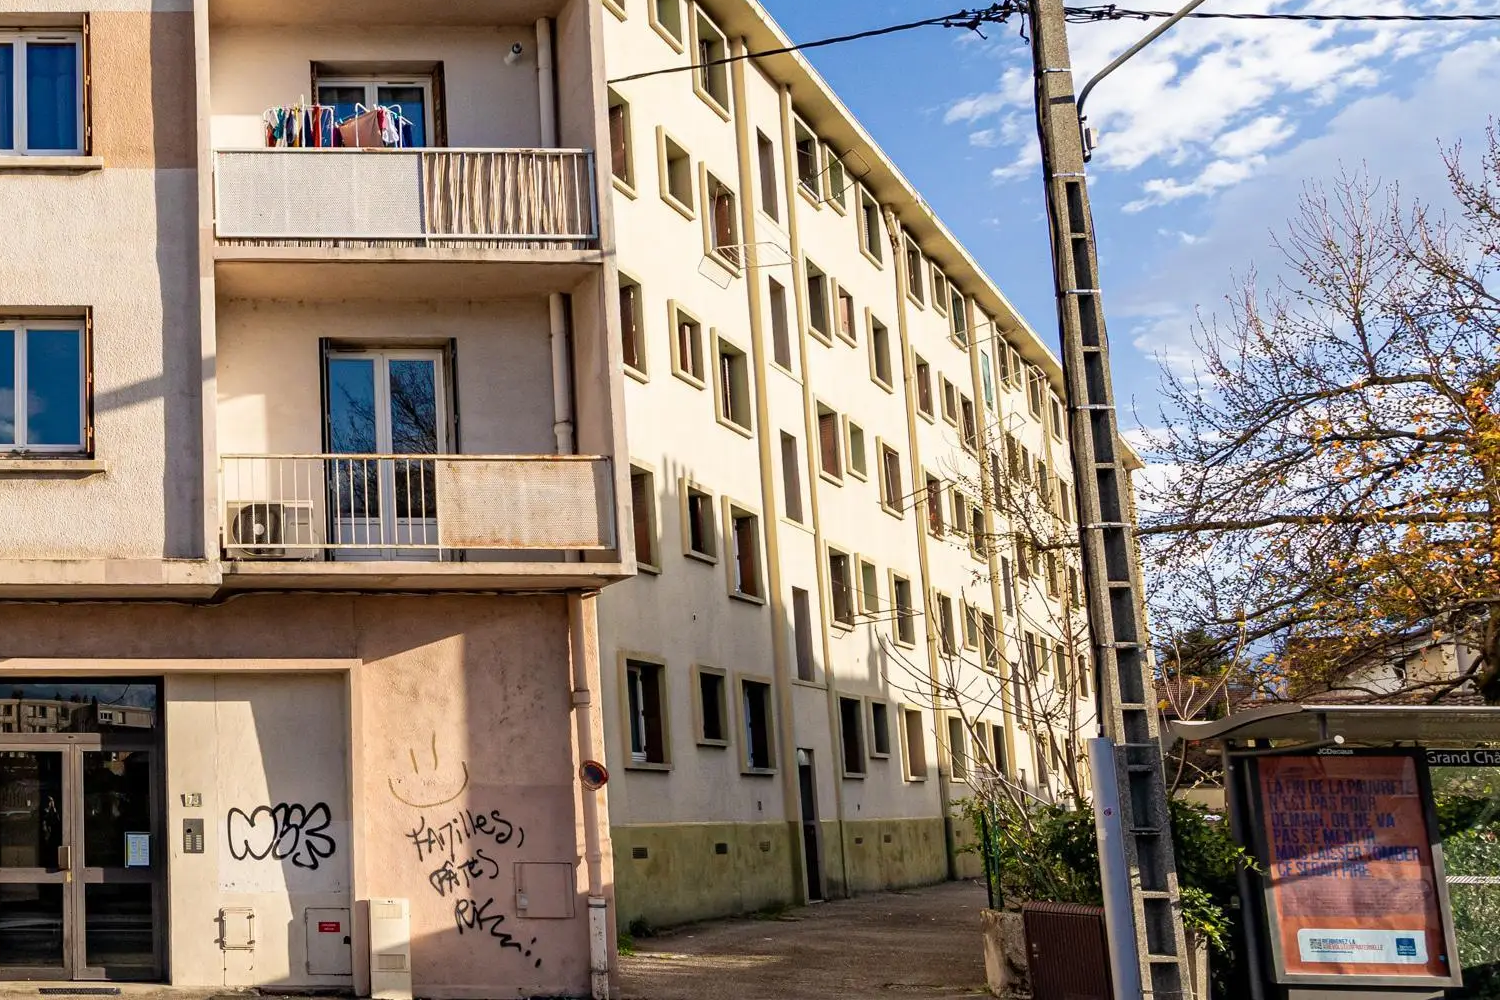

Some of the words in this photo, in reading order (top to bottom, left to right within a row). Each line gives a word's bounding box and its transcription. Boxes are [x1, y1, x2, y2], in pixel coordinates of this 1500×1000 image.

[1426, 751, 1470, 764] Grand
[1267, 779, 1283, 795] LA
[1286, 779, 1307, 795] FIN
[1308, 779, 1324, 795] DE
[1328, 779, 1346, 795] LA
[1311, 795, 1338, 811] PAS
[1341, 796, 1376, 812] POUR
[1332, 812, 1350, 828] ON
[1353, 812, 1372, 828] NE
[1376, 813, 1396, 828] VA
[1273, 828, 1300, 845] PAS
[1303, 828, 1320, 845] SE
[1322, 829, 1376, 845] MENTIR
[1278, 861, 1294, 877] CE
[1343, 862, 1371, 879] PIRE
